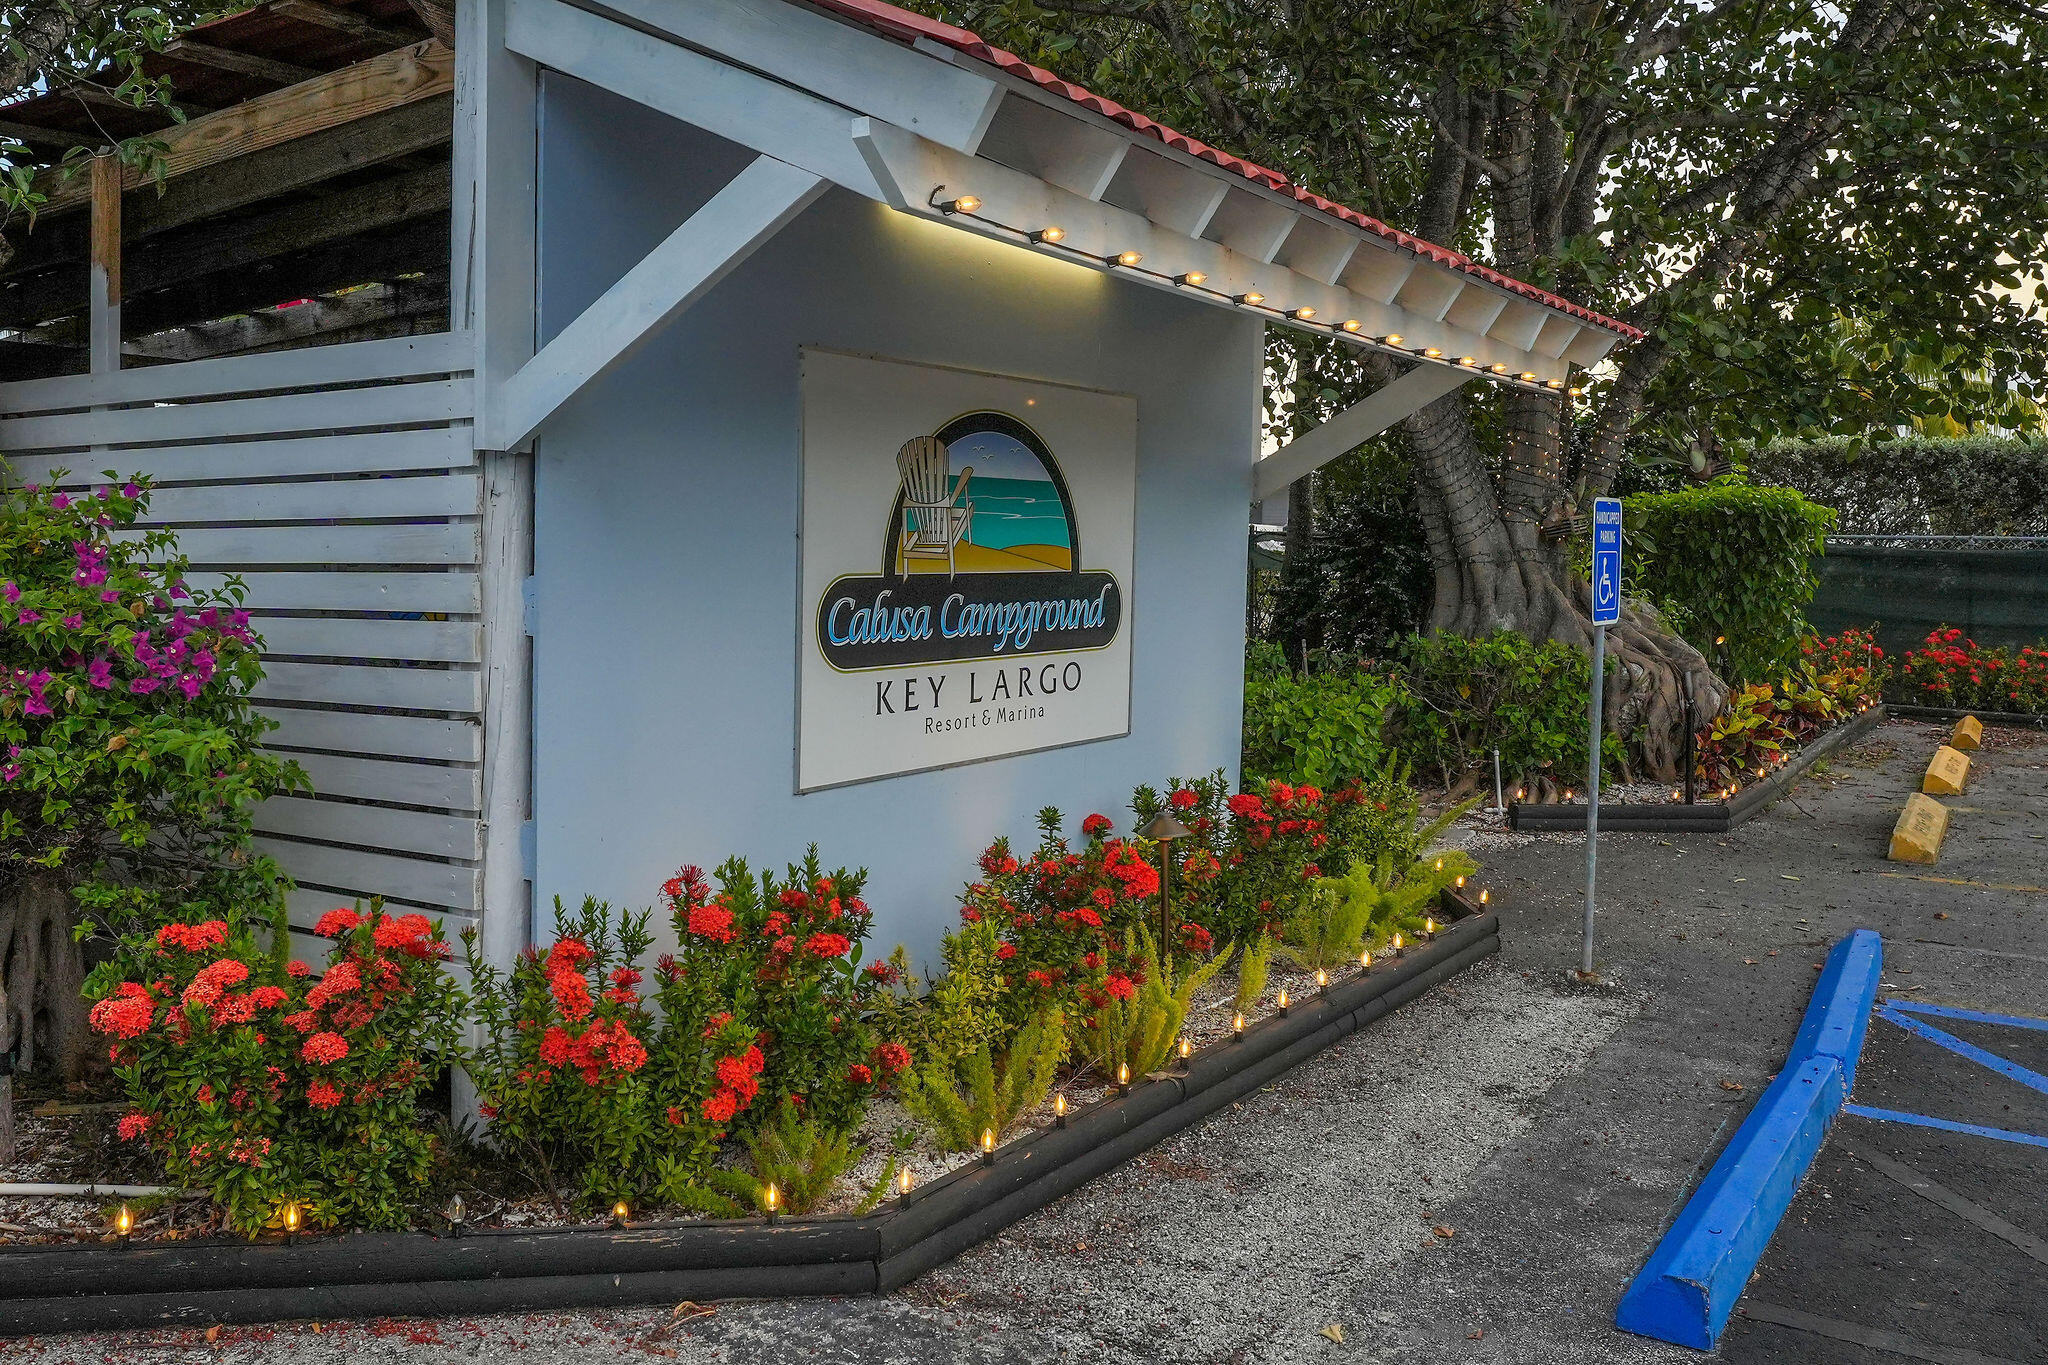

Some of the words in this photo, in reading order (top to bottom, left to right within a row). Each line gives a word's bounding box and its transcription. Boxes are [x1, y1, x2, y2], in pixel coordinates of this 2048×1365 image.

[1596, 511, 1619, 524] HANDICAPPED
[1600, 530, 1616, 543] PARKING
[828, 590, 933, 647] Calusa
[939, 583, 1113, 652] Campground
[875, 675, 947, 716] KEY
[969, 661, 1083, 704] LARGO
[924, 717, 977, 734] Resort
[981, 709, 992, 726] &
[996, 704, 1045, 724] Marina
